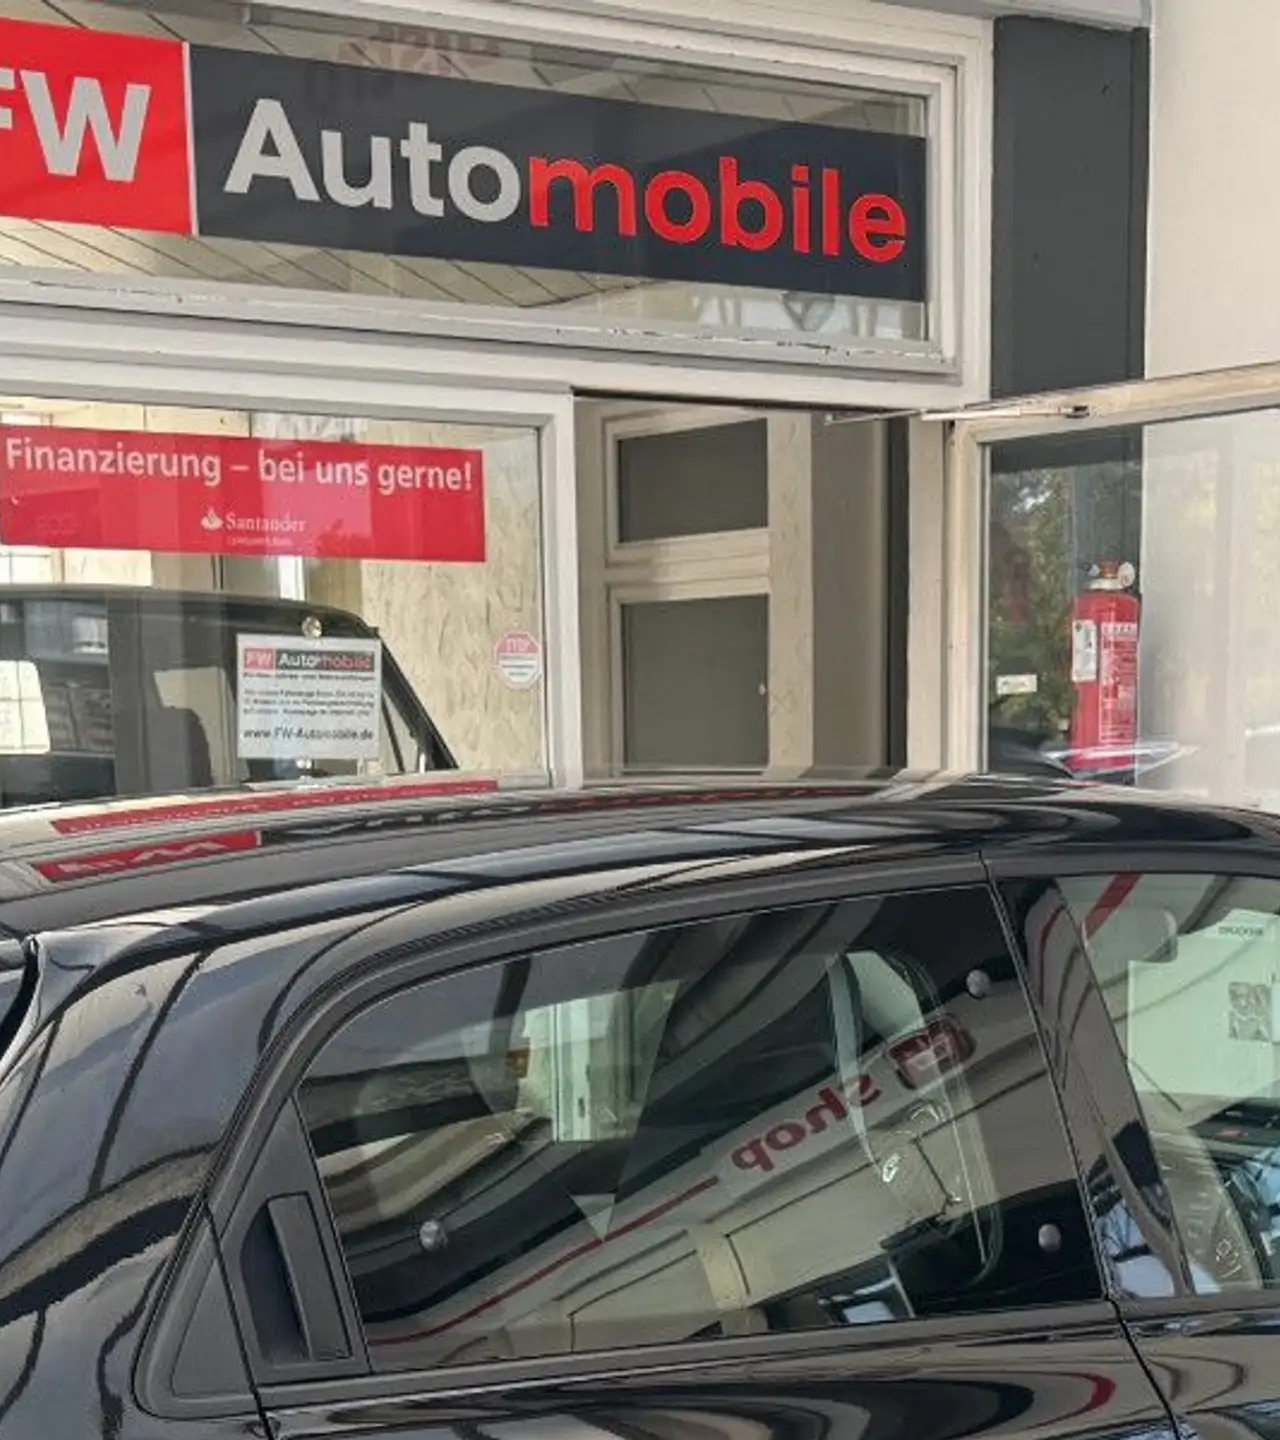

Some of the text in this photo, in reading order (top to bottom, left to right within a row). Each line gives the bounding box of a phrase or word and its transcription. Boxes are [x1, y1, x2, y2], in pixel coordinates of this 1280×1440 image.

[224, 98, 907, 263] Automobile
[5, 437, 221, 488] Finanzierung
[258, 450, 305, 483] bei
[316, 464, 368, 487] uns
[377, 461, 473, 494] gerne!
[225, 511, 308, 534] Santander
